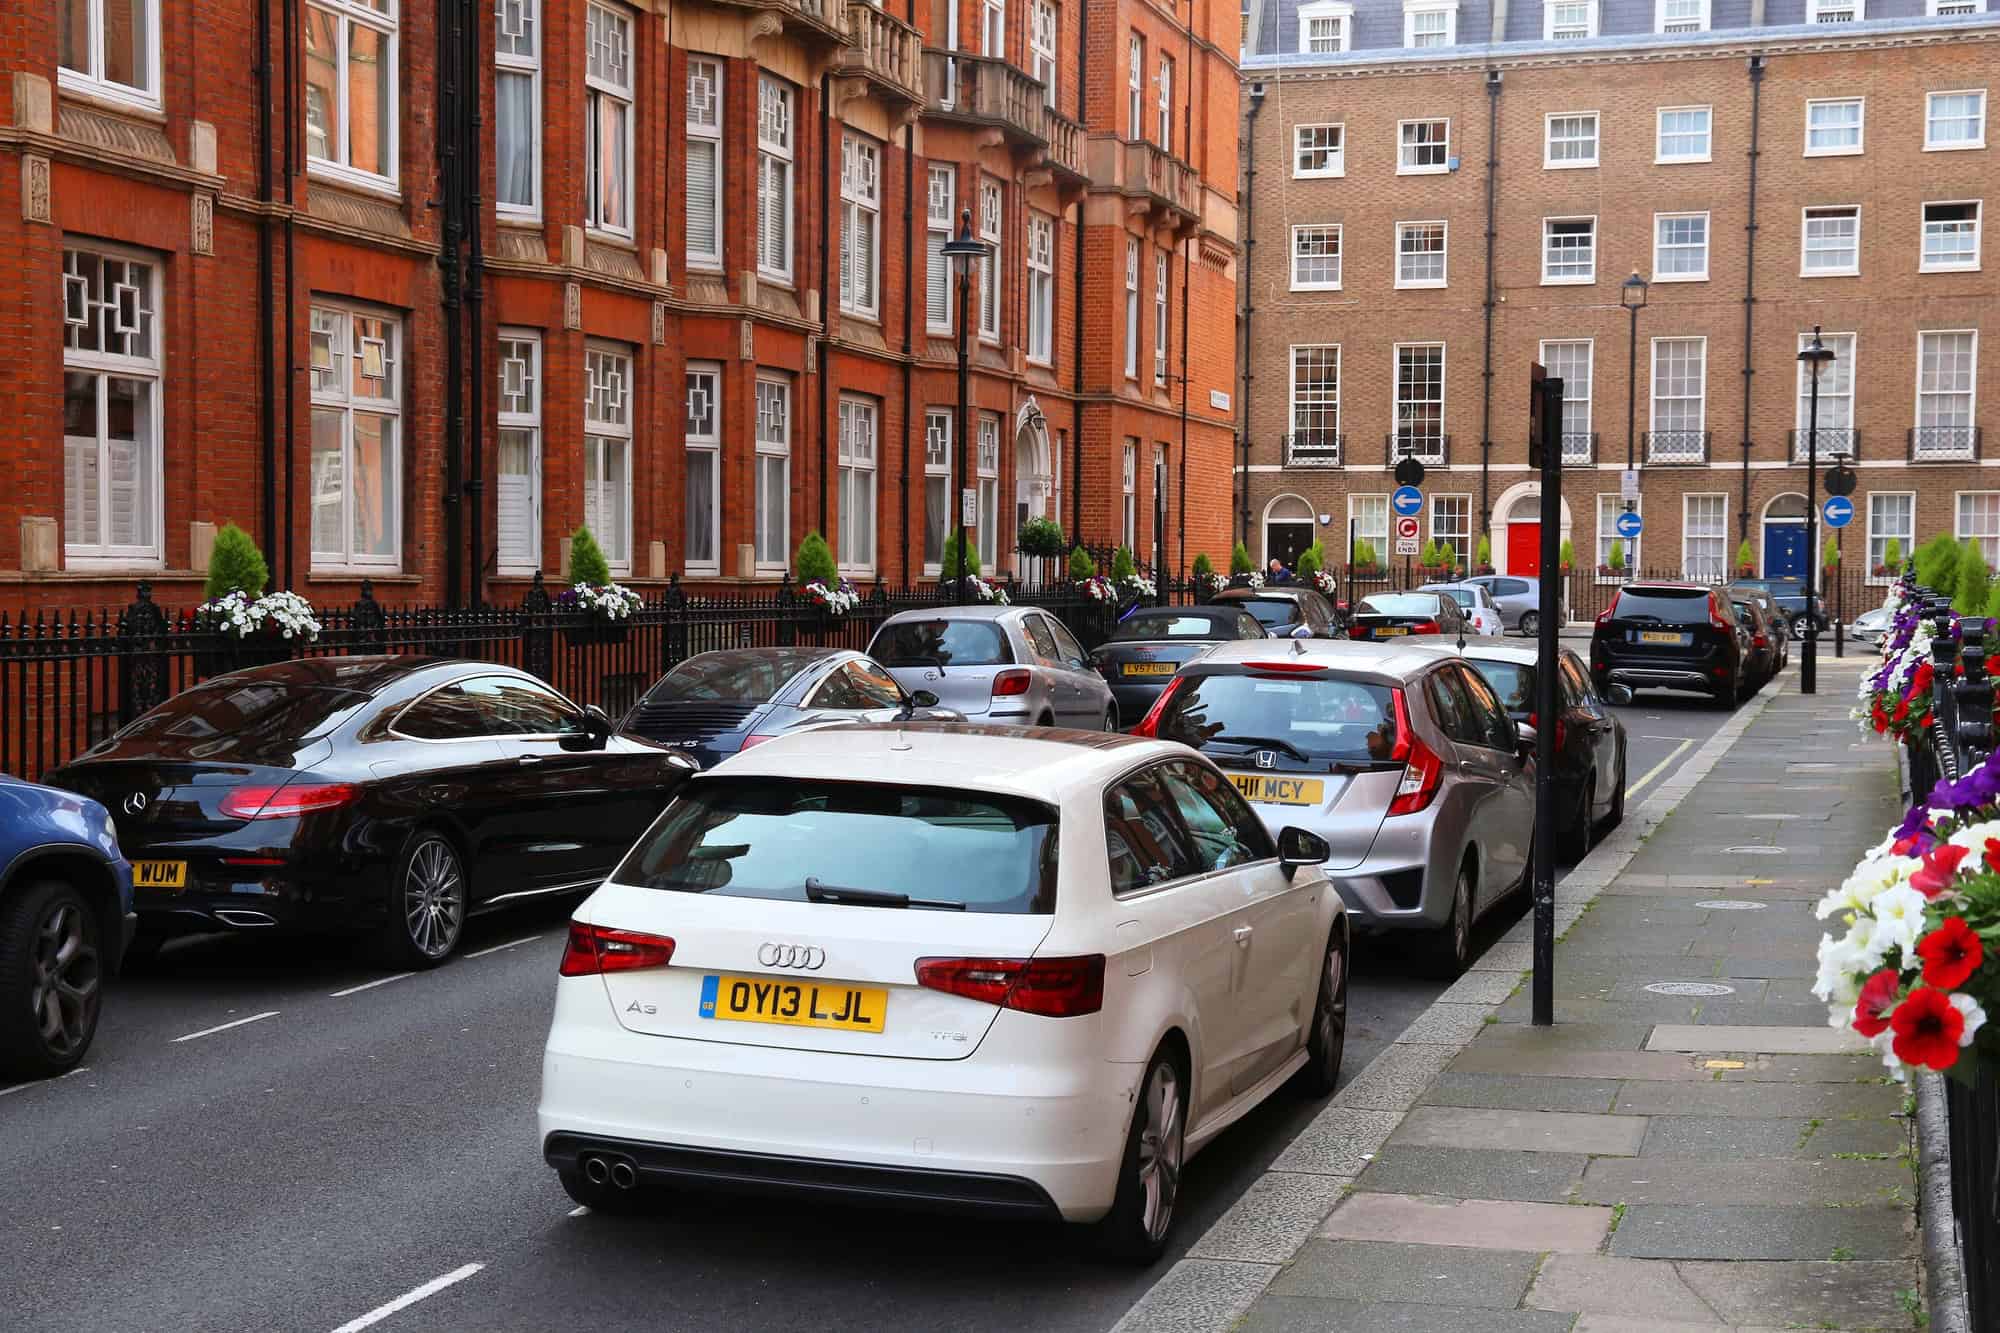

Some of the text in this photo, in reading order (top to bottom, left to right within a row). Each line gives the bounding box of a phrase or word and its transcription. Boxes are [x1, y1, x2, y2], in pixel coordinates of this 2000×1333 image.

[1264, 779, 1305, 800] MCY
[141, 863, 179, 882] WUM
[626, 999, 657, 1015] A3
[730, 981, 871, 1024] OY13 LJL
